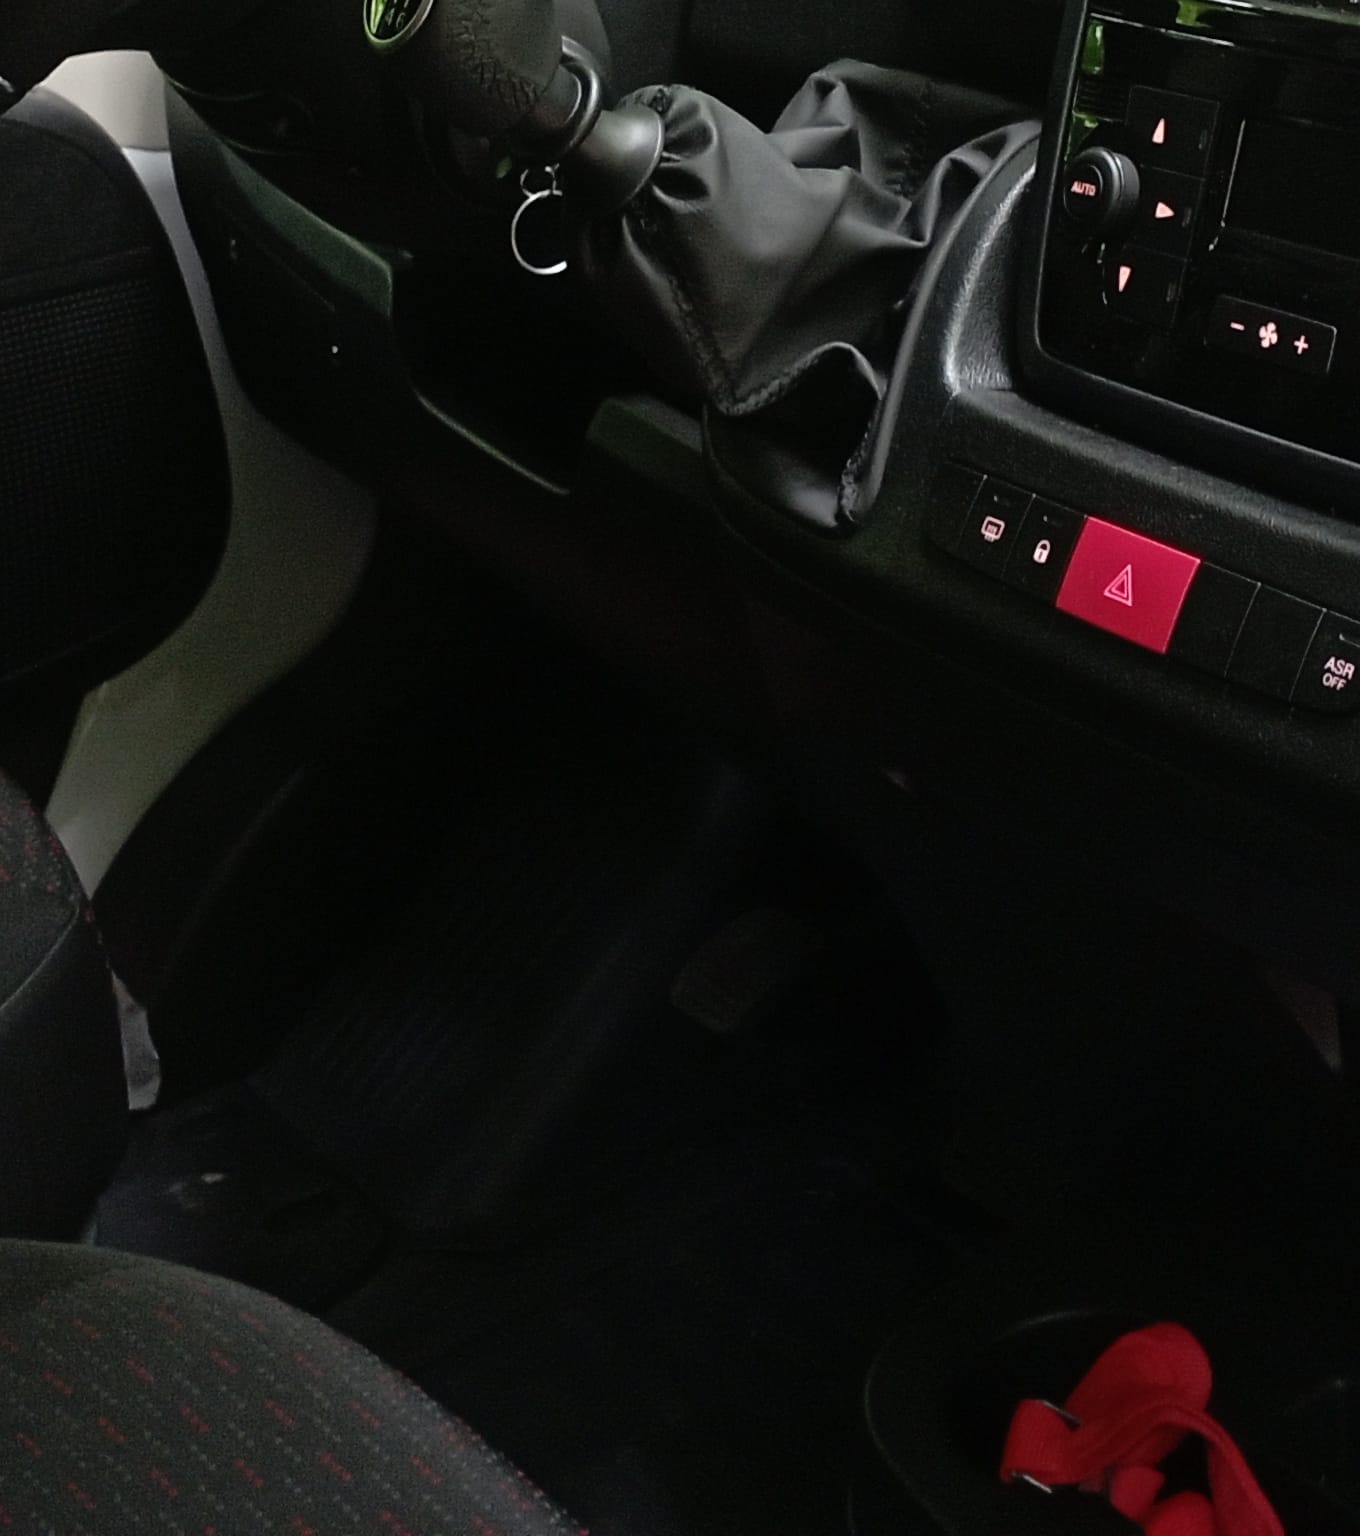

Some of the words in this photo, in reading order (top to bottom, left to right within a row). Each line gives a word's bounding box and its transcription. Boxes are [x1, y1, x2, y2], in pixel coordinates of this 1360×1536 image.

[1070, 180, 1096, 196] AUTO
[1323, 656, 1356, 681] ASR
[1322, 672, 1348, 691] OFF
